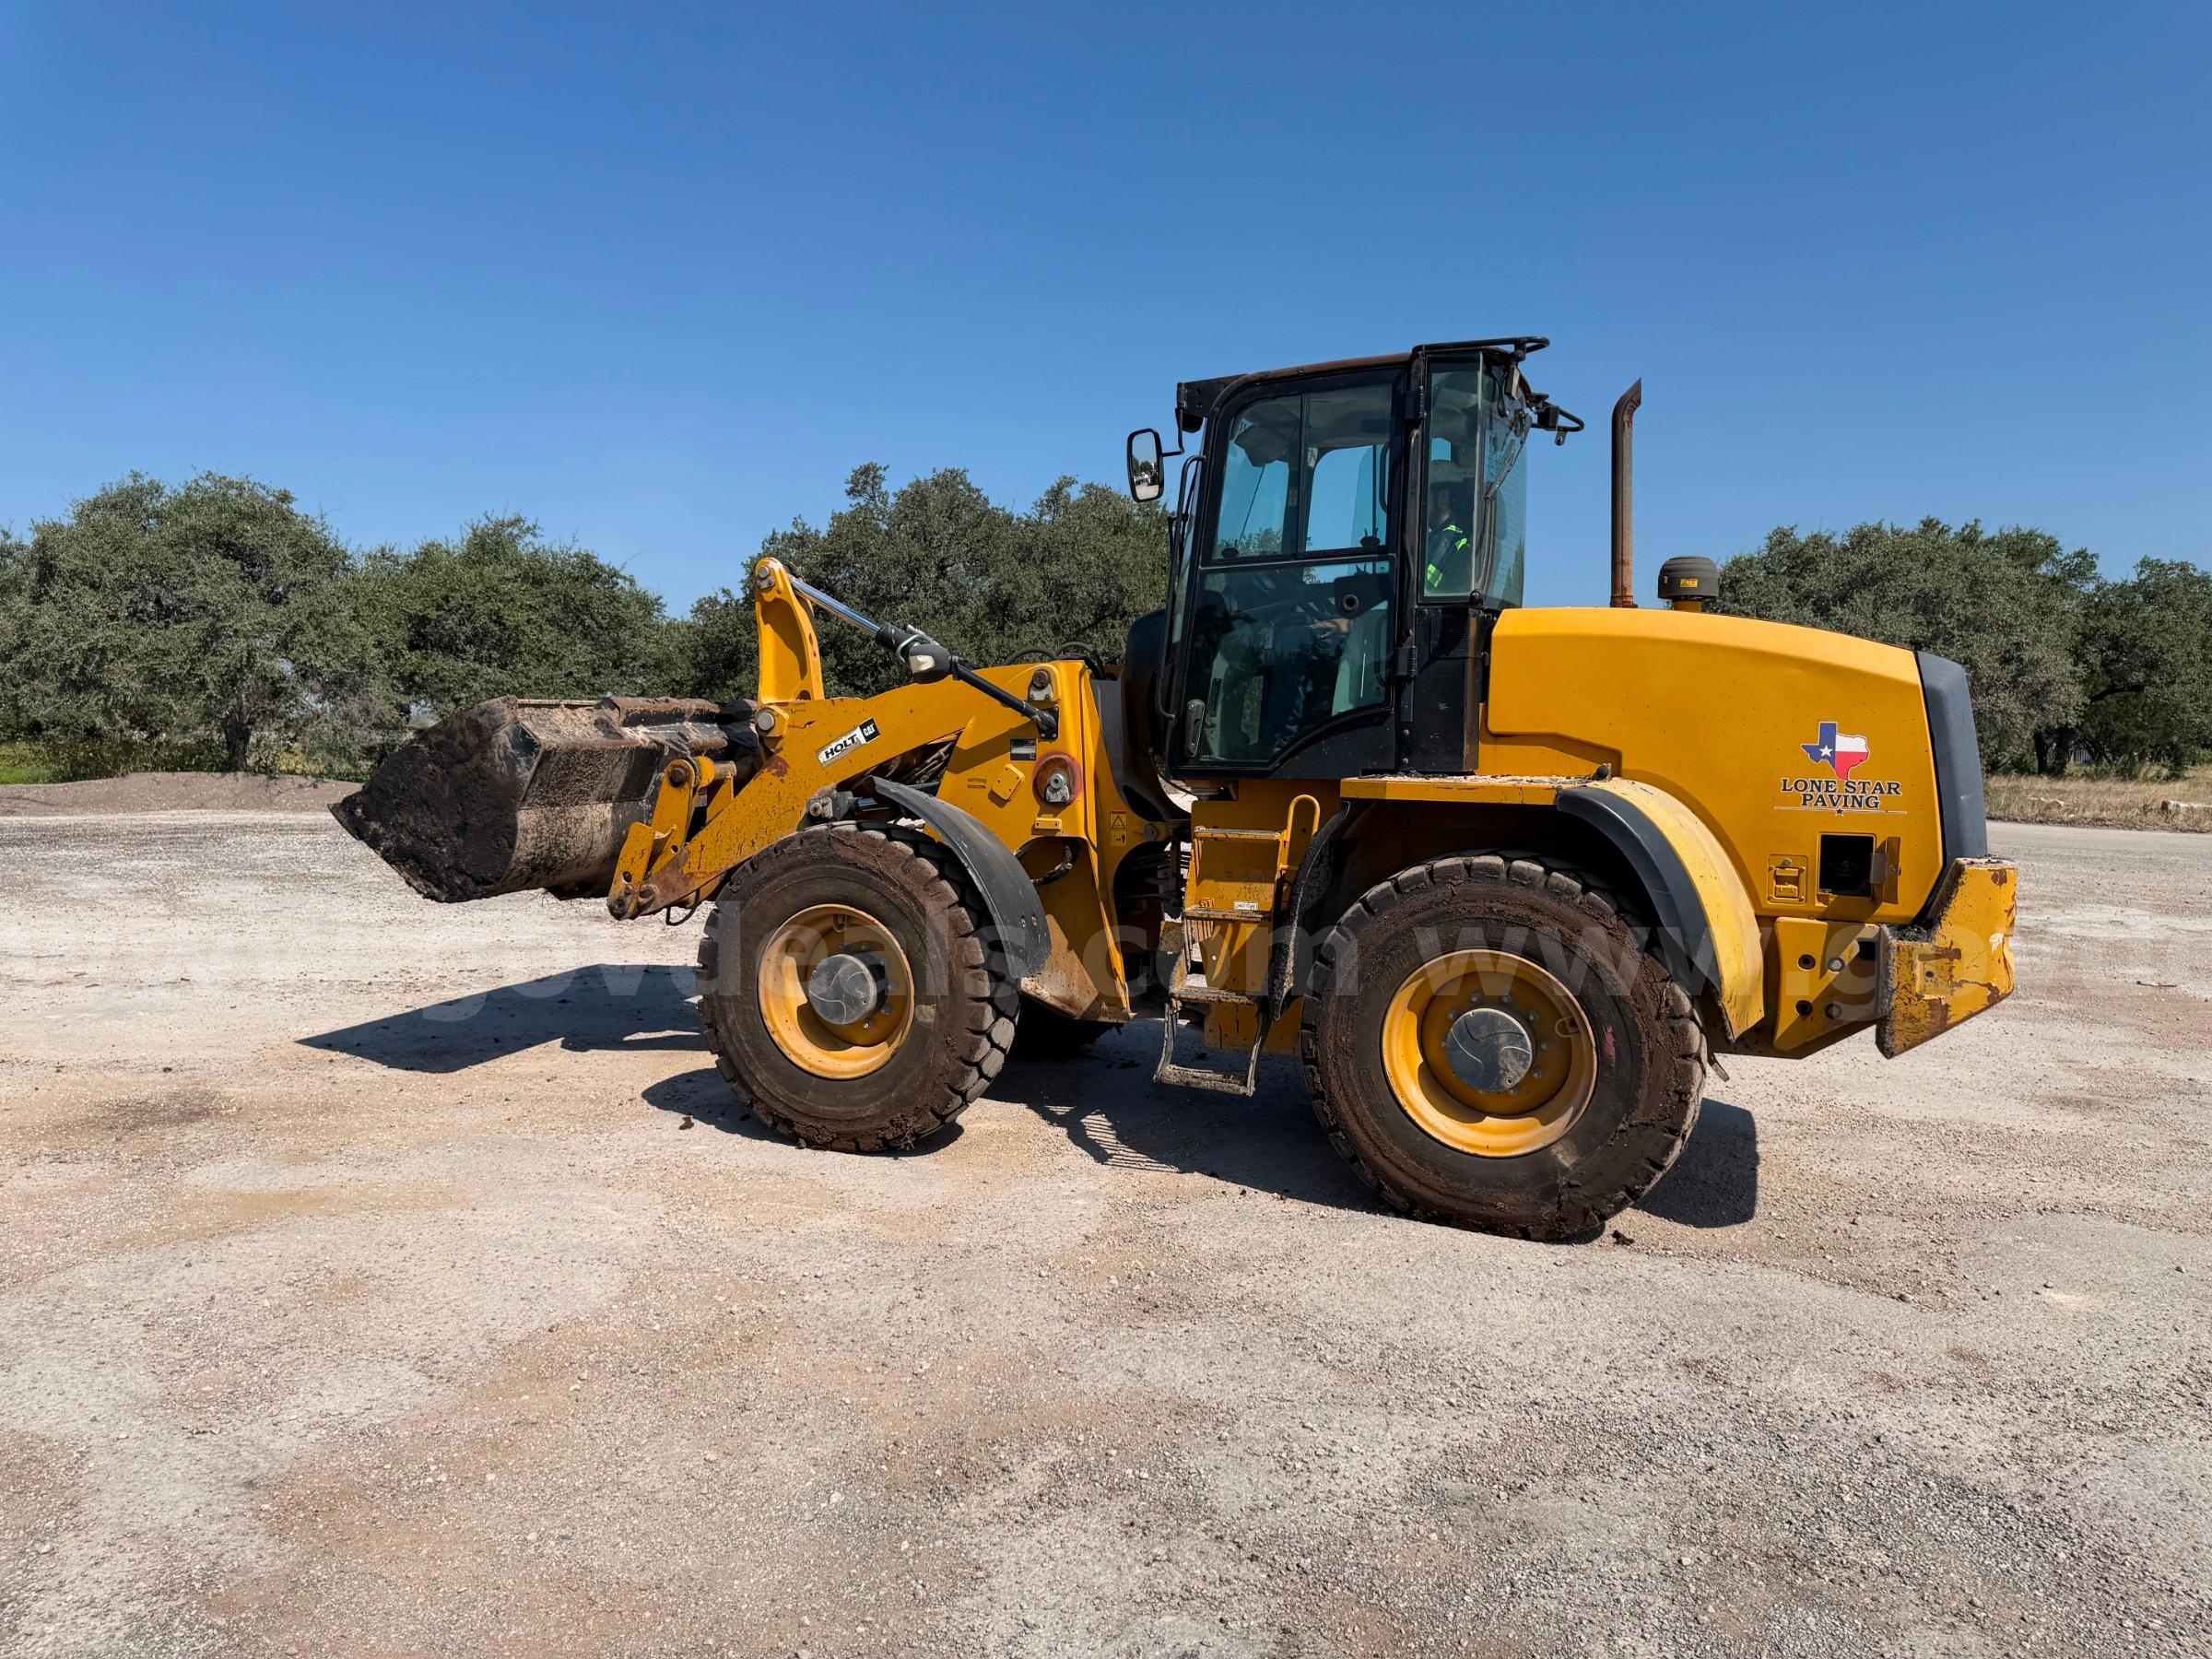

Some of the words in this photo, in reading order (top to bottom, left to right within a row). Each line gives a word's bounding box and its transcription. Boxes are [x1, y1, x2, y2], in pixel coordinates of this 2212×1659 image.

[824, 734, 857, 759] HOLT
[863, 724, 876, 736] CAT
[1781, 778, 1838, 794] LONE
[1844, 780, 1901, 795] STAR
[1801, 793, 1880, 809] PAVING
